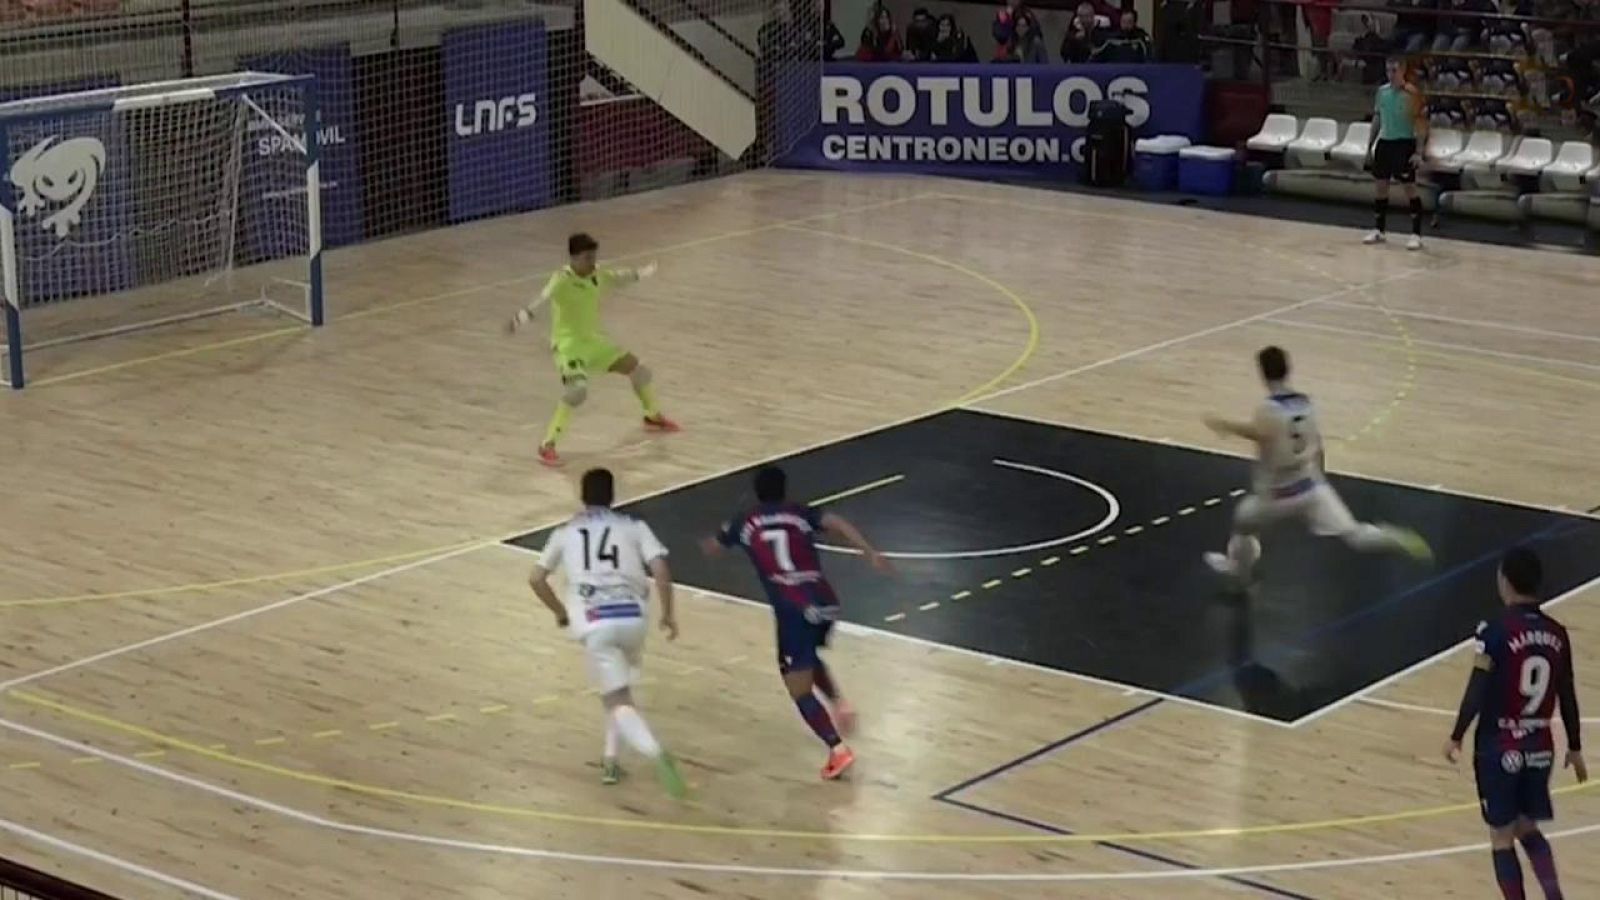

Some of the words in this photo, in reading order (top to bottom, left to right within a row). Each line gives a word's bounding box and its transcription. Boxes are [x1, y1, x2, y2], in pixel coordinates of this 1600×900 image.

[821, 76, 1151, 127] ROTULOS
[578, 526, 620, 570] 14
[760, 529, 794, 571] 7
[1519, 655, 1551, 716] 9
